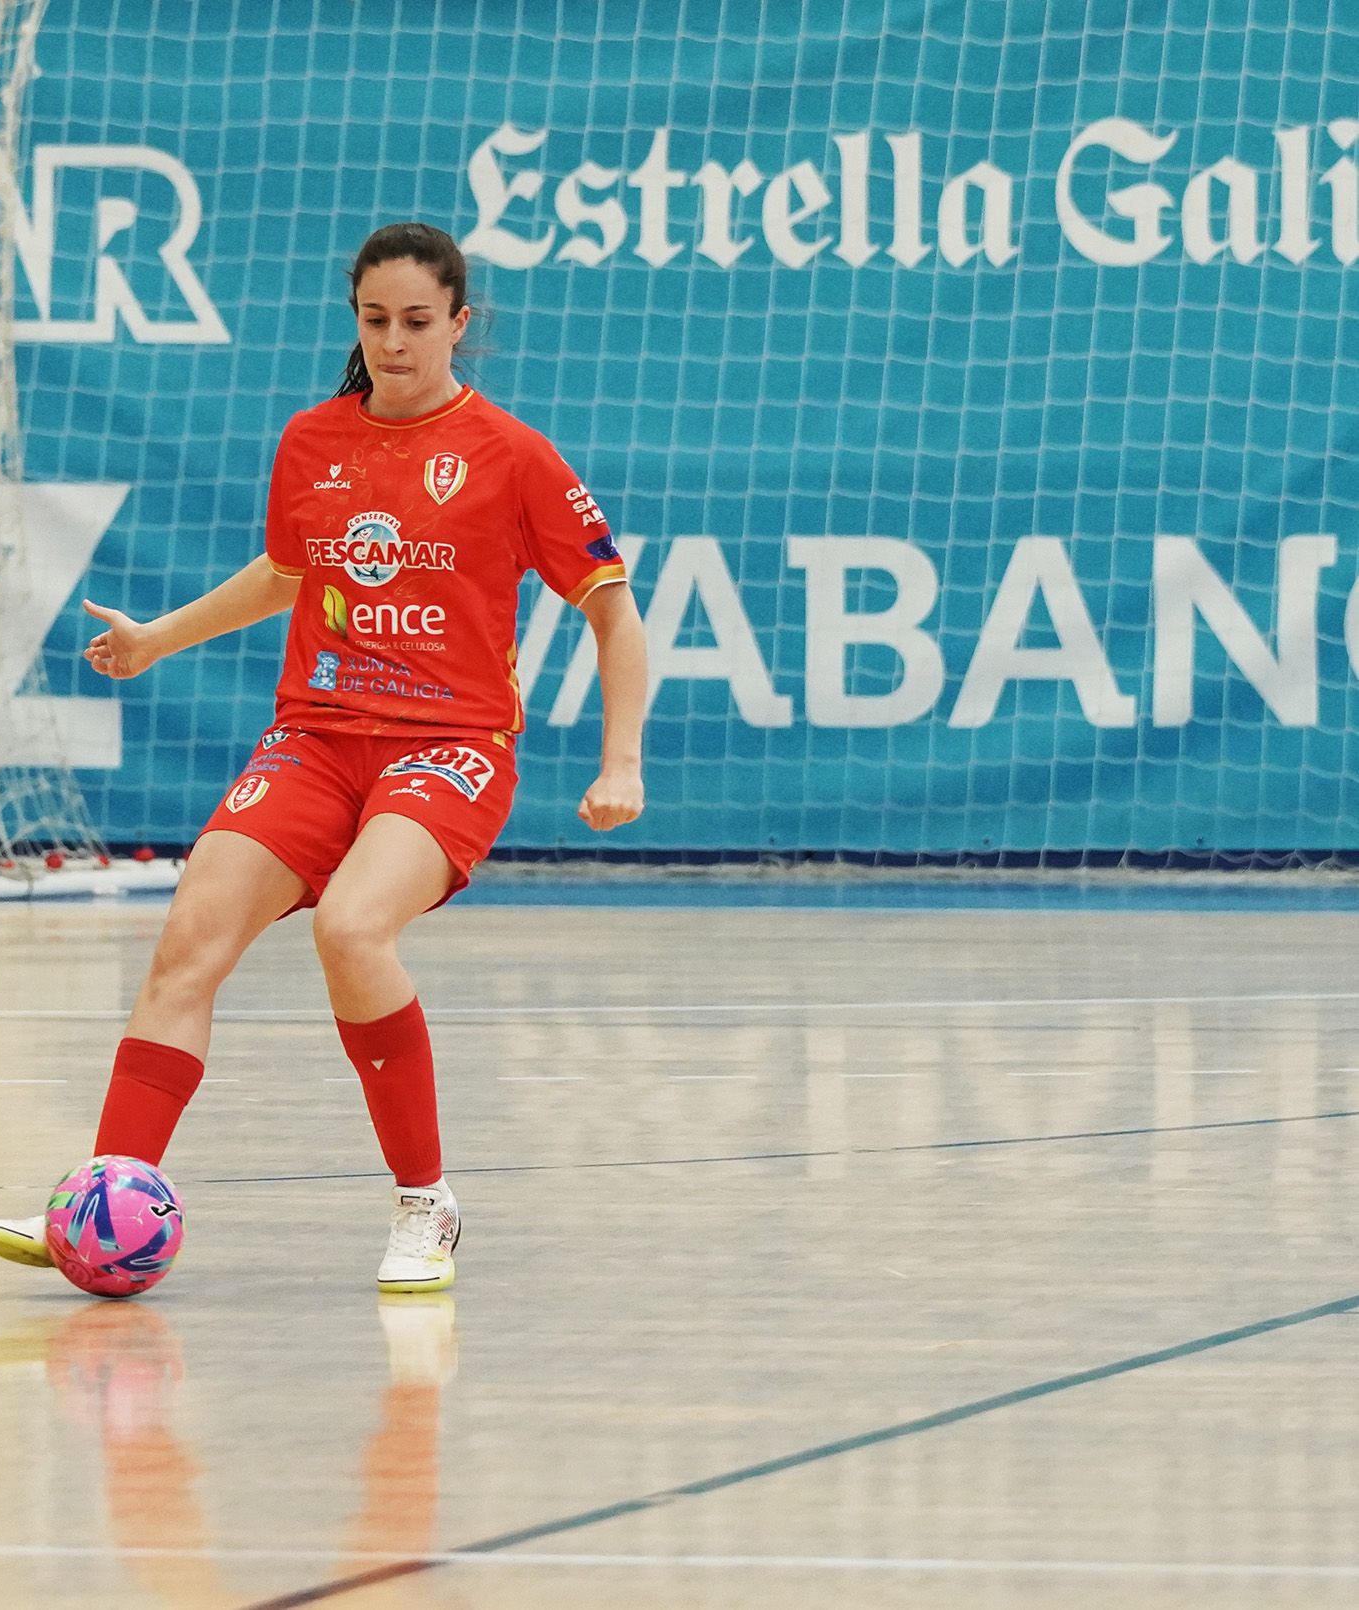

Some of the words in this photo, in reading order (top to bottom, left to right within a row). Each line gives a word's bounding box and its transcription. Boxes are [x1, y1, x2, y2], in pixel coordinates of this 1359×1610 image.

[460, 120, 1020, 270] Estrella
[313, 479, 352, 490] CARACAL
[349, 512, 400, 529] CONSERVAS
[305, 538, 455, 571] PESCAMAR
[352, 603, 446, 636] ence
[400, 641, 447, 651] CELULOSA
[345, 656, 412, 678] XUNTA
[342, 676, 365, 692] DE
[370, 678, 455, 700] GALICIA
